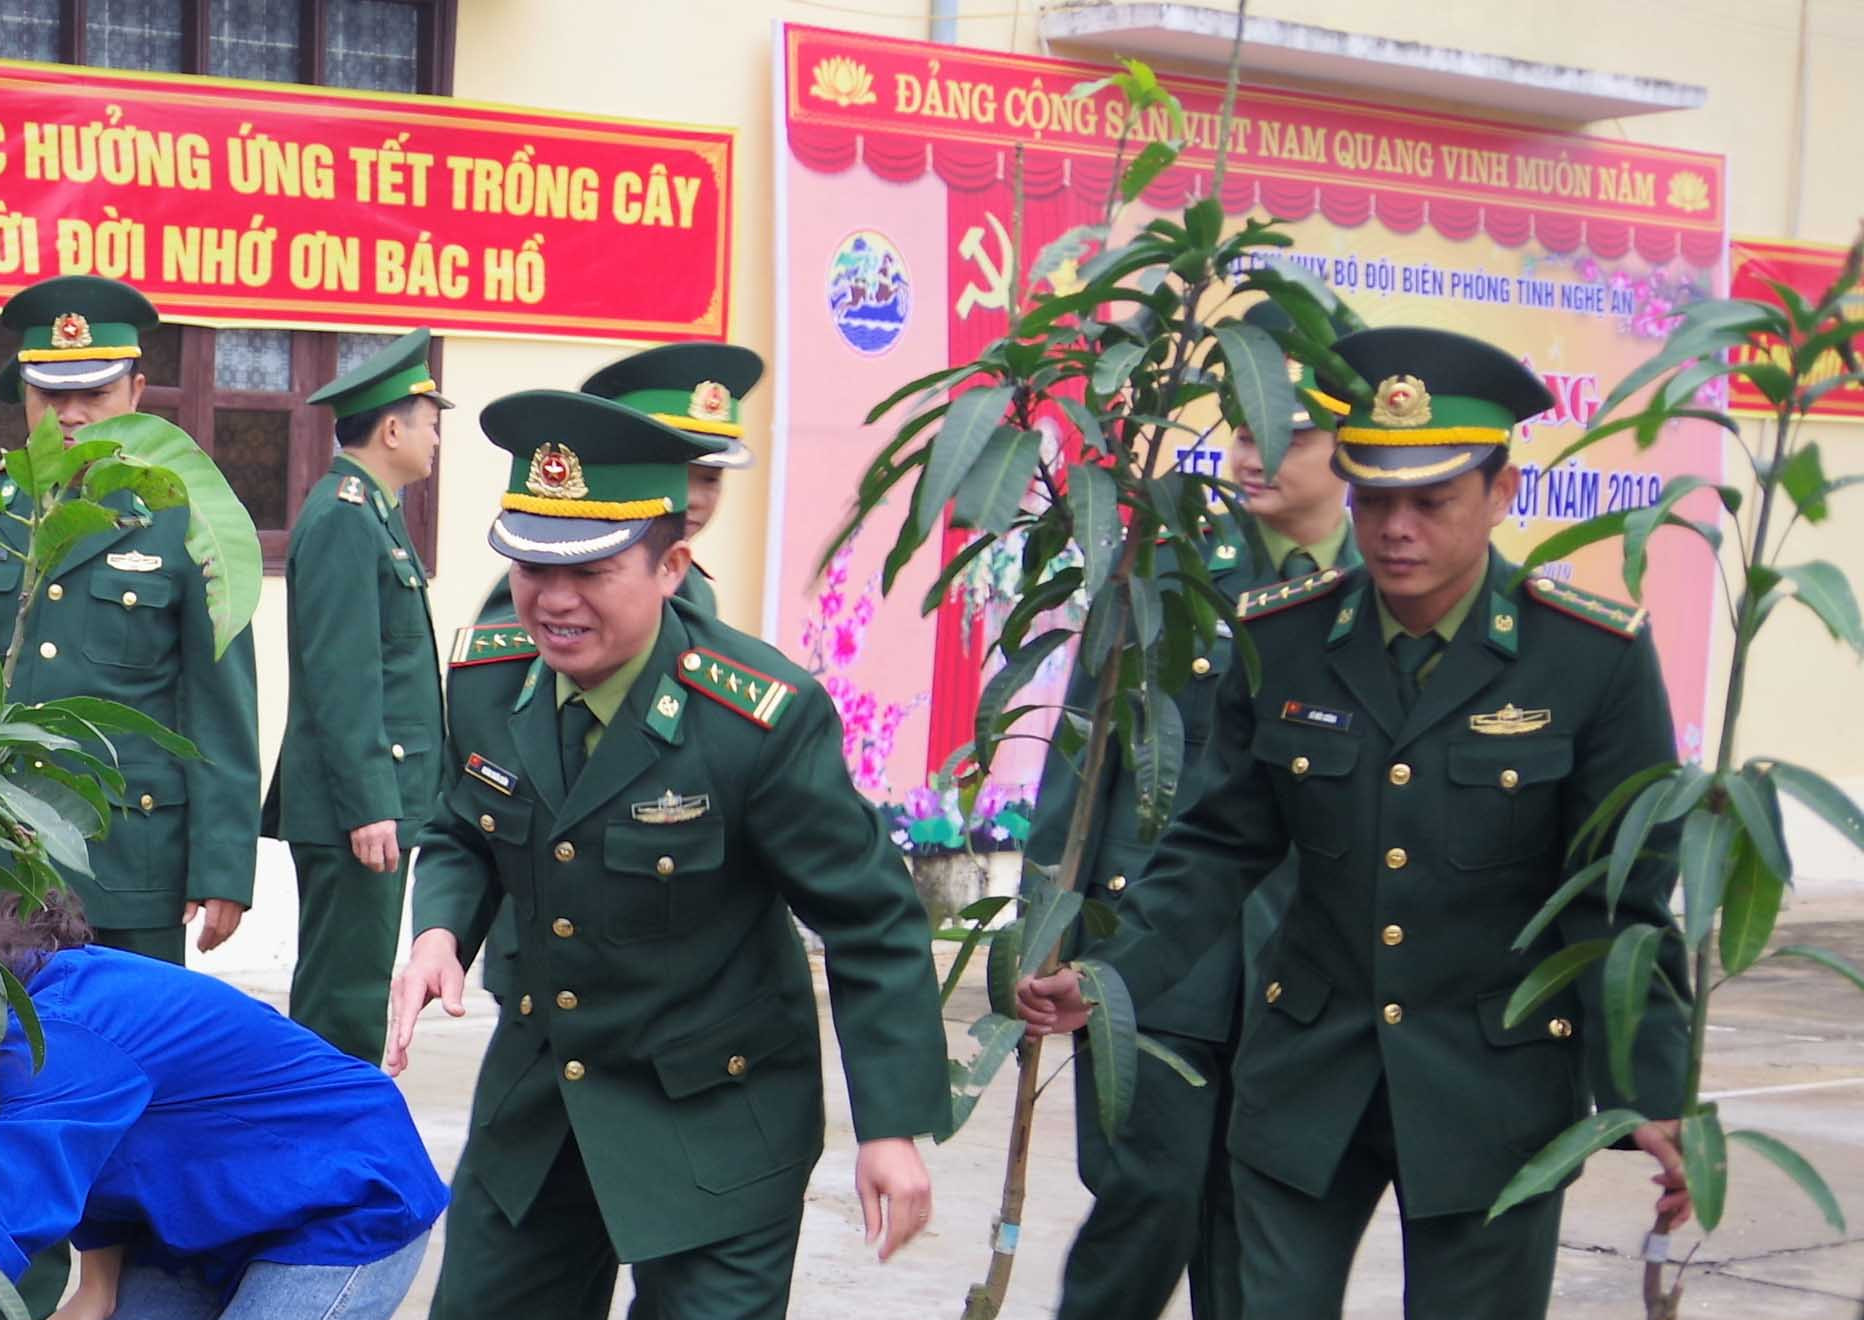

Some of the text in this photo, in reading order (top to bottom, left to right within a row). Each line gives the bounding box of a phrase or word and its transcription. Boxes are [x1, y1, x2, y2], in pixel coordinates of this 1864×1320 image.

[24, 104, 212, 191] HƯỞNG
[226, 122, 336, 200] ỨNG
[348, 131, 434, 207] TẾT
[445, 143, 600, 221] TRỒNG
[612, 164, 702, 229] CÂY
[893, 61, 997, 124] ĐẢNG
[1003, 77, 1098, 141] CỘNG
[1257, 119, 1327, 164] NAM
[1333, 130, 1435, 178] QUANG
[1440, 145, 1510, 189] VINH
[1514, 152, 1592, 200] MUÔN
[1598, 163, 1656, 207] NĂM
[56, 205, 146, 281] ĐỜI
[162, 215, 277, 286] NHỚ
[289, 230, 361, 293] ƠN
[374, 231, 470, 300] BÁC
[484, 232, 547, 304] HỒ
[1333, 253, 1359, 292] BỘ
[1364, 260, 1397, 299] ĐỘI
[1401, 262, 1444, 297] BIÊN
[1450, 265, 1511, 305] PHÒNG
[1610, 283, 1634, 315] AN
[1547, 459, 1601, 519] NĂM
[1607, 472, 1661, 513] 2019
